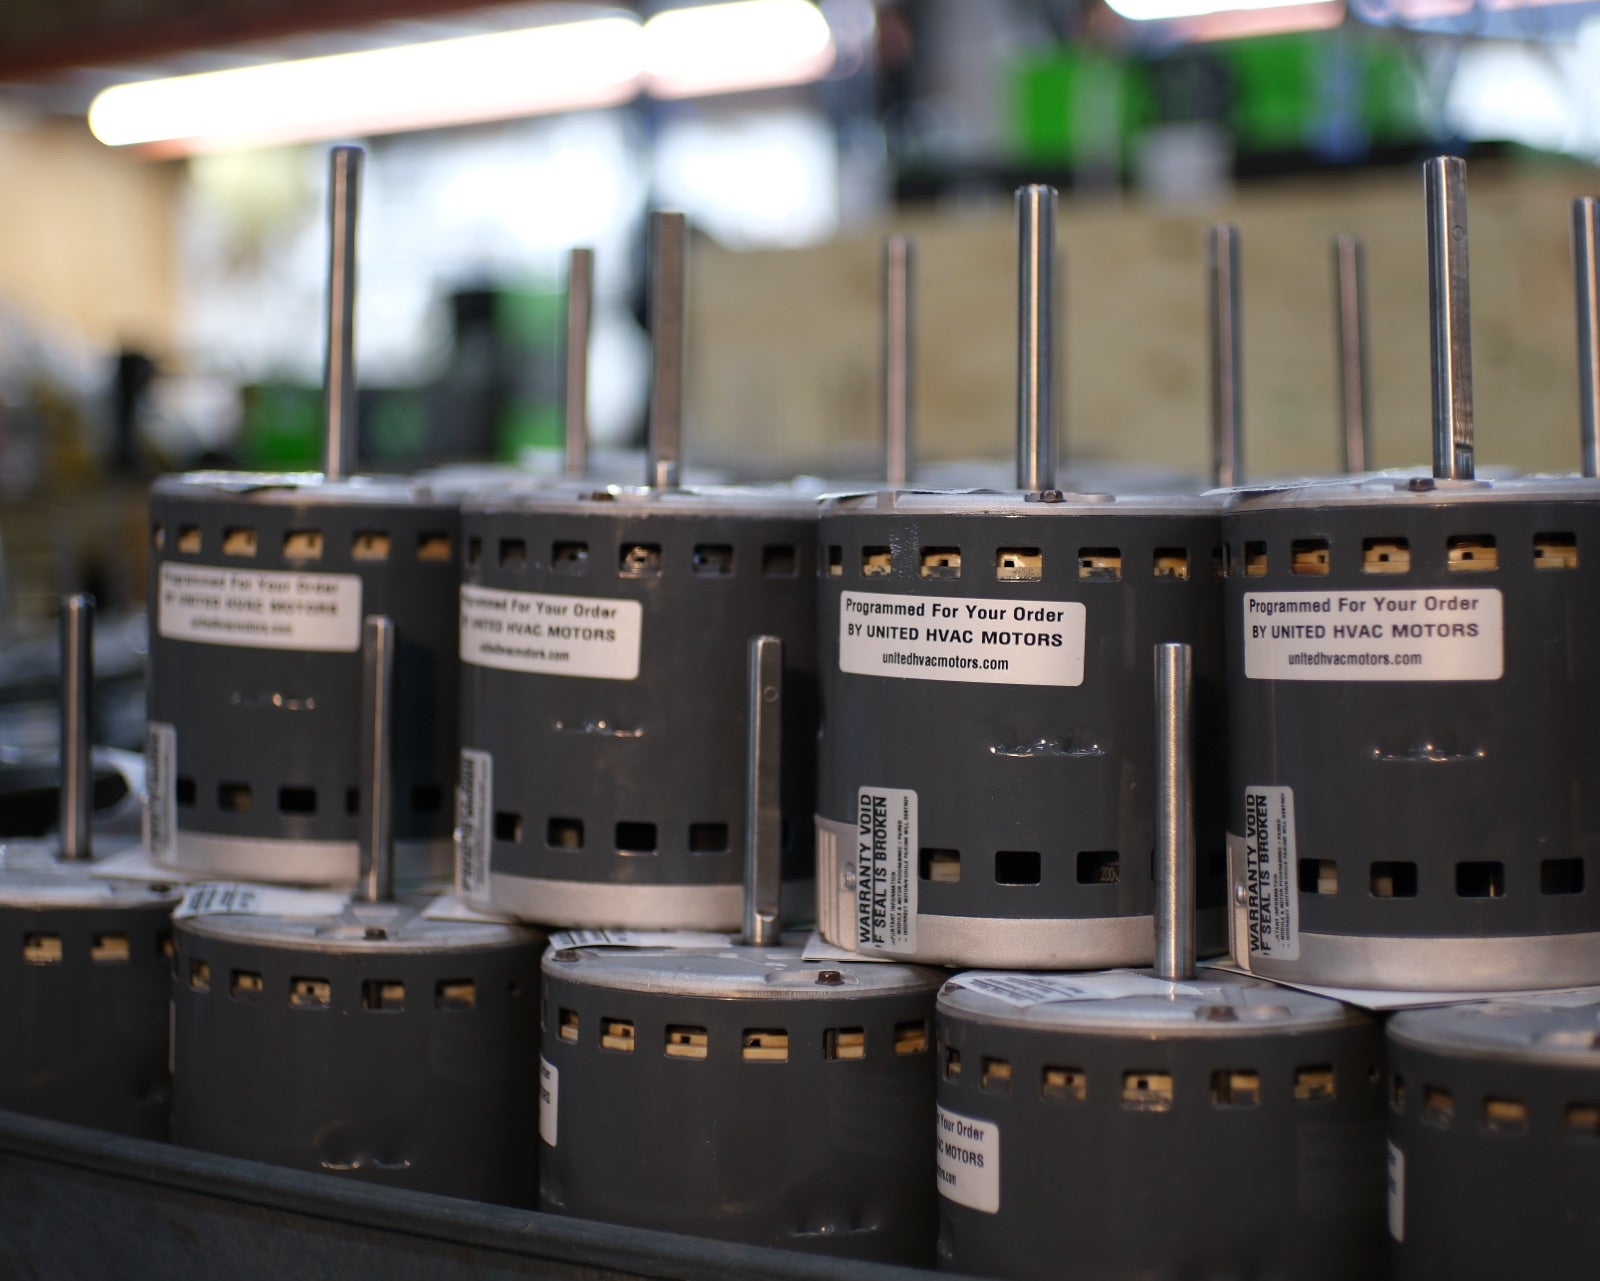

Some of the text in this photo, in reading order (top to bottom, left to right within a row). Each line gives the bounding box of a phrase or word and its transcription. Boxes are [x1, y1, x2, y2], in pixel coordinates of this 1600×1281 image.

[511, 599, 530, 613] For
[536, 602, 568, 616] Your
[574, 604, 617, 618] Order
[846, 599, 1064, 622] Programmed For Your Order
[1250, 596, 1479, 616] Programmed For Your Order
[507, 622, 541, 636] HVAC
[547, 626, 615, 641] MOTORS
[848, 623, 1063, 647] BY UNITED HVAC MOTORS
[1252, 623, 1479, 638] BY UNITED HVAC MOTORS
[882, 652, 1009, 670] unitedhvacmotors.com
[1289, 652, 1422, 666] unitedhvacmotors.com
[874, 796, 887, 861] BROKEN
[1257, 796, 1269, 863] BROKEN
[859, 794, 871, 943] WARRANTY VOID
[874, 868, 886, 882] IS
[1246, 794, 1259, 952] WARRANTY VOID
[1259, 871, 1270, 885] IS
[874, 889, 886, 928] SEAL
[1259, 892, 1271, 934] SEAL
[940, 1113, 984, 1141] Your Order
[945, 1143, 984, 1168] MOTORS
